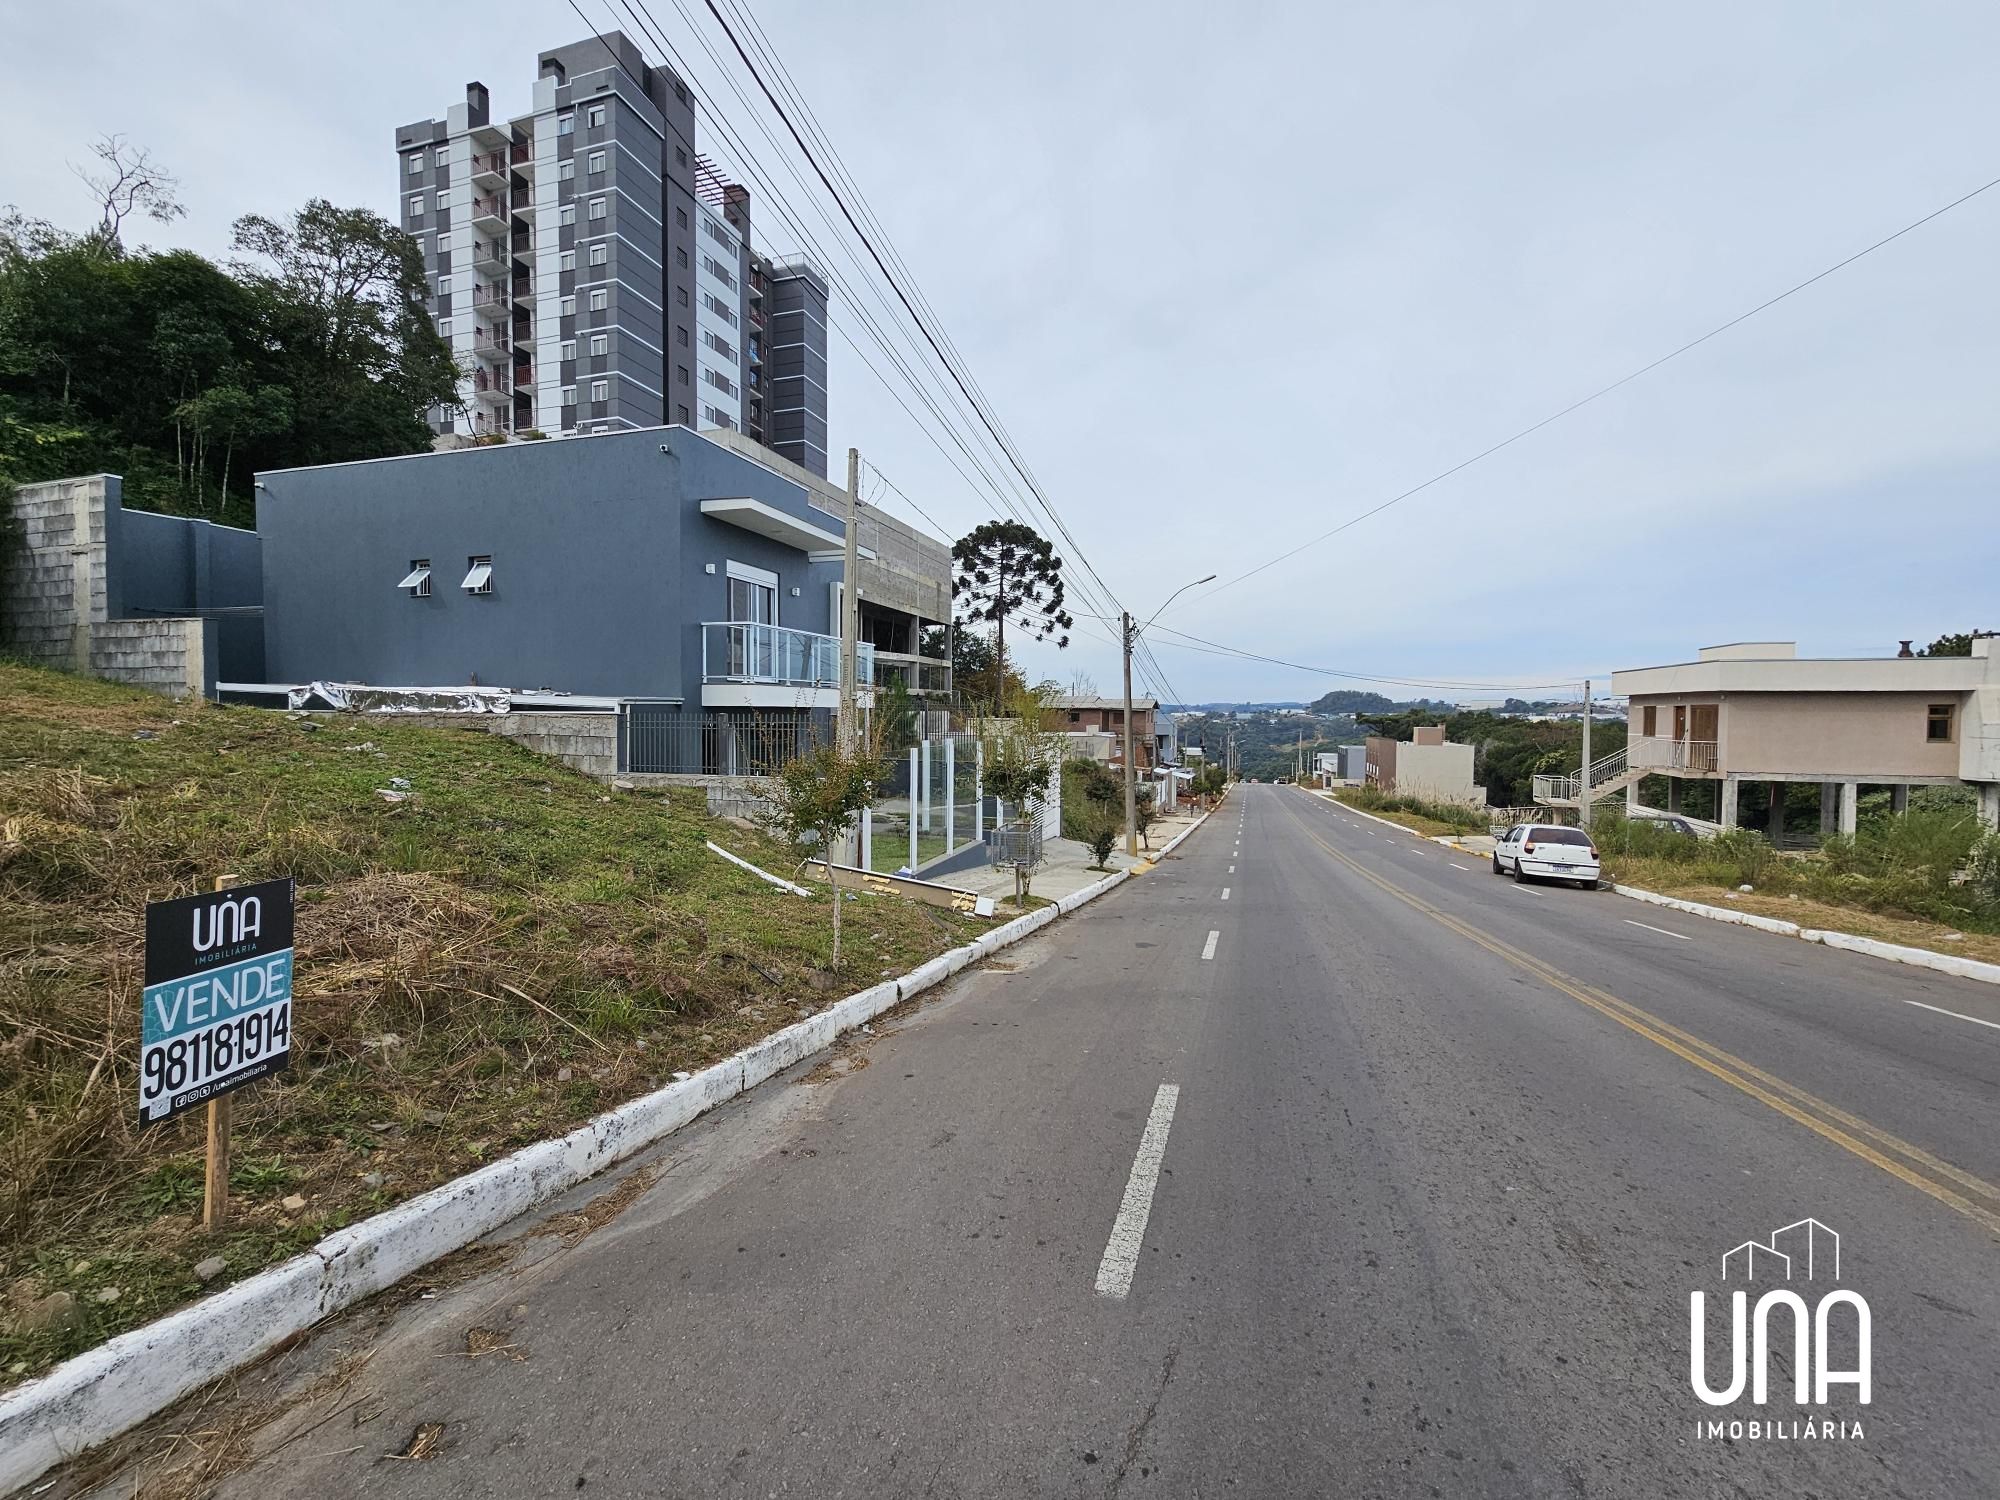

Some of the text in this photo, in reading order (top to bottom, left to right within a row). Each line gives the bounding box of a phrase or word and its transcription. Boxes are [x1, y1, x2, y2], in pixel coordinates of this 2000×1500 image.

[193, 896, 261, 951] UNA
[195, 944, 257, 966] IMOBILIÁRIA
[155, 958, 286, 1032] VENDE
[213, 1064, 267, 1092] /uaimobiliaria
